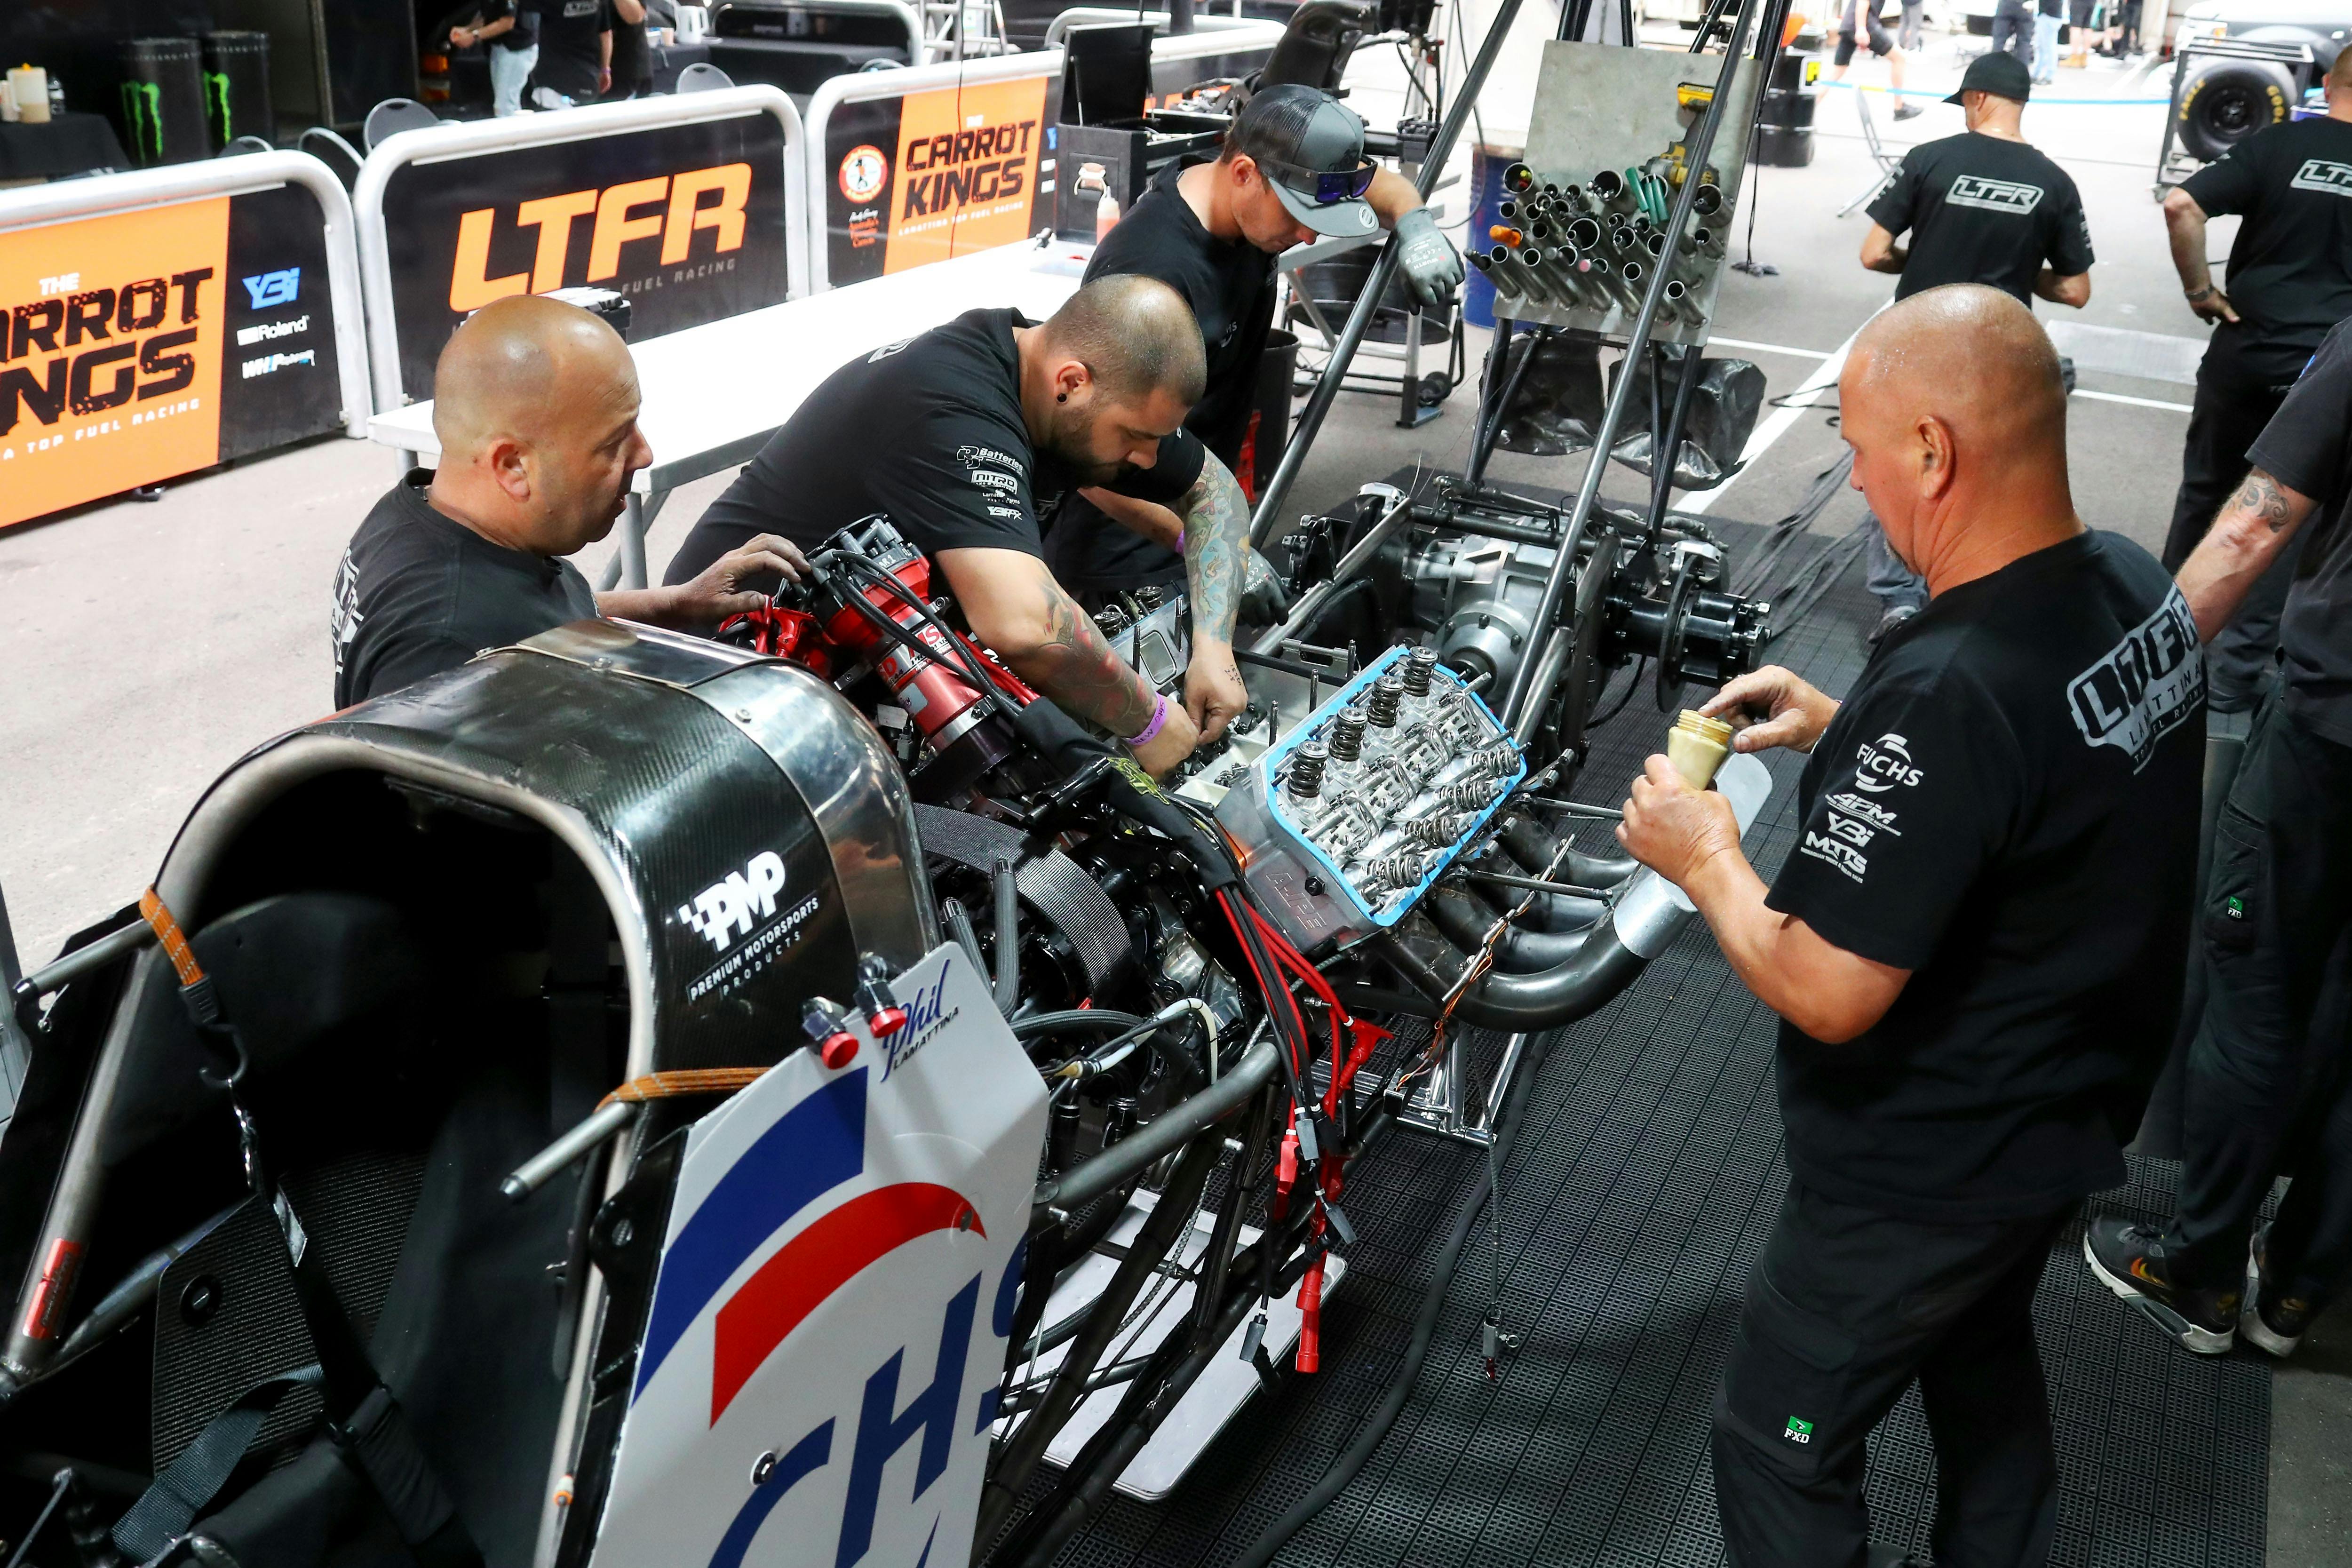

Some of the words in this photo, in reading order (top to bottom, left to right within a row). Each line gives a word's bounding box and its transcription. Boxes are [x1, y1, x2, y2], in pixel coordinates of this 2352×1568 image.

[907, 120, 1036, 171] CARROT
[902, 157, 1026, 223] KINGS
[1954, 179, 2037, 207] LTFR
[449, 162, 752, 312] LTFR
[39, 272, 79, 296] THE
[621, 277, 663, 296] FUEL
[674, 258, 736, 282] RACING
[0, 267, 213, 365] RROT
[258, 315, 308, 342] Roland
[27, 434, 64, 454] TOP
[75, 420, 121, 441] FUEL
[132, 398, 200, 426] RACING
[979, 448, 1024, 471] Batteries
[1856, 743, 1924, 787] FUCHS
[693, 851, 786, 952] PMP
[690, 954, 742, 1001] PREMIUM
[744, 897, 819, 960] MOTORSPORTS
[723, 931, 801, 996] PRODUCTS
[880, 958, 951, 1083] Phil
[893, 1006, 959, 1070] LAMATTINA
